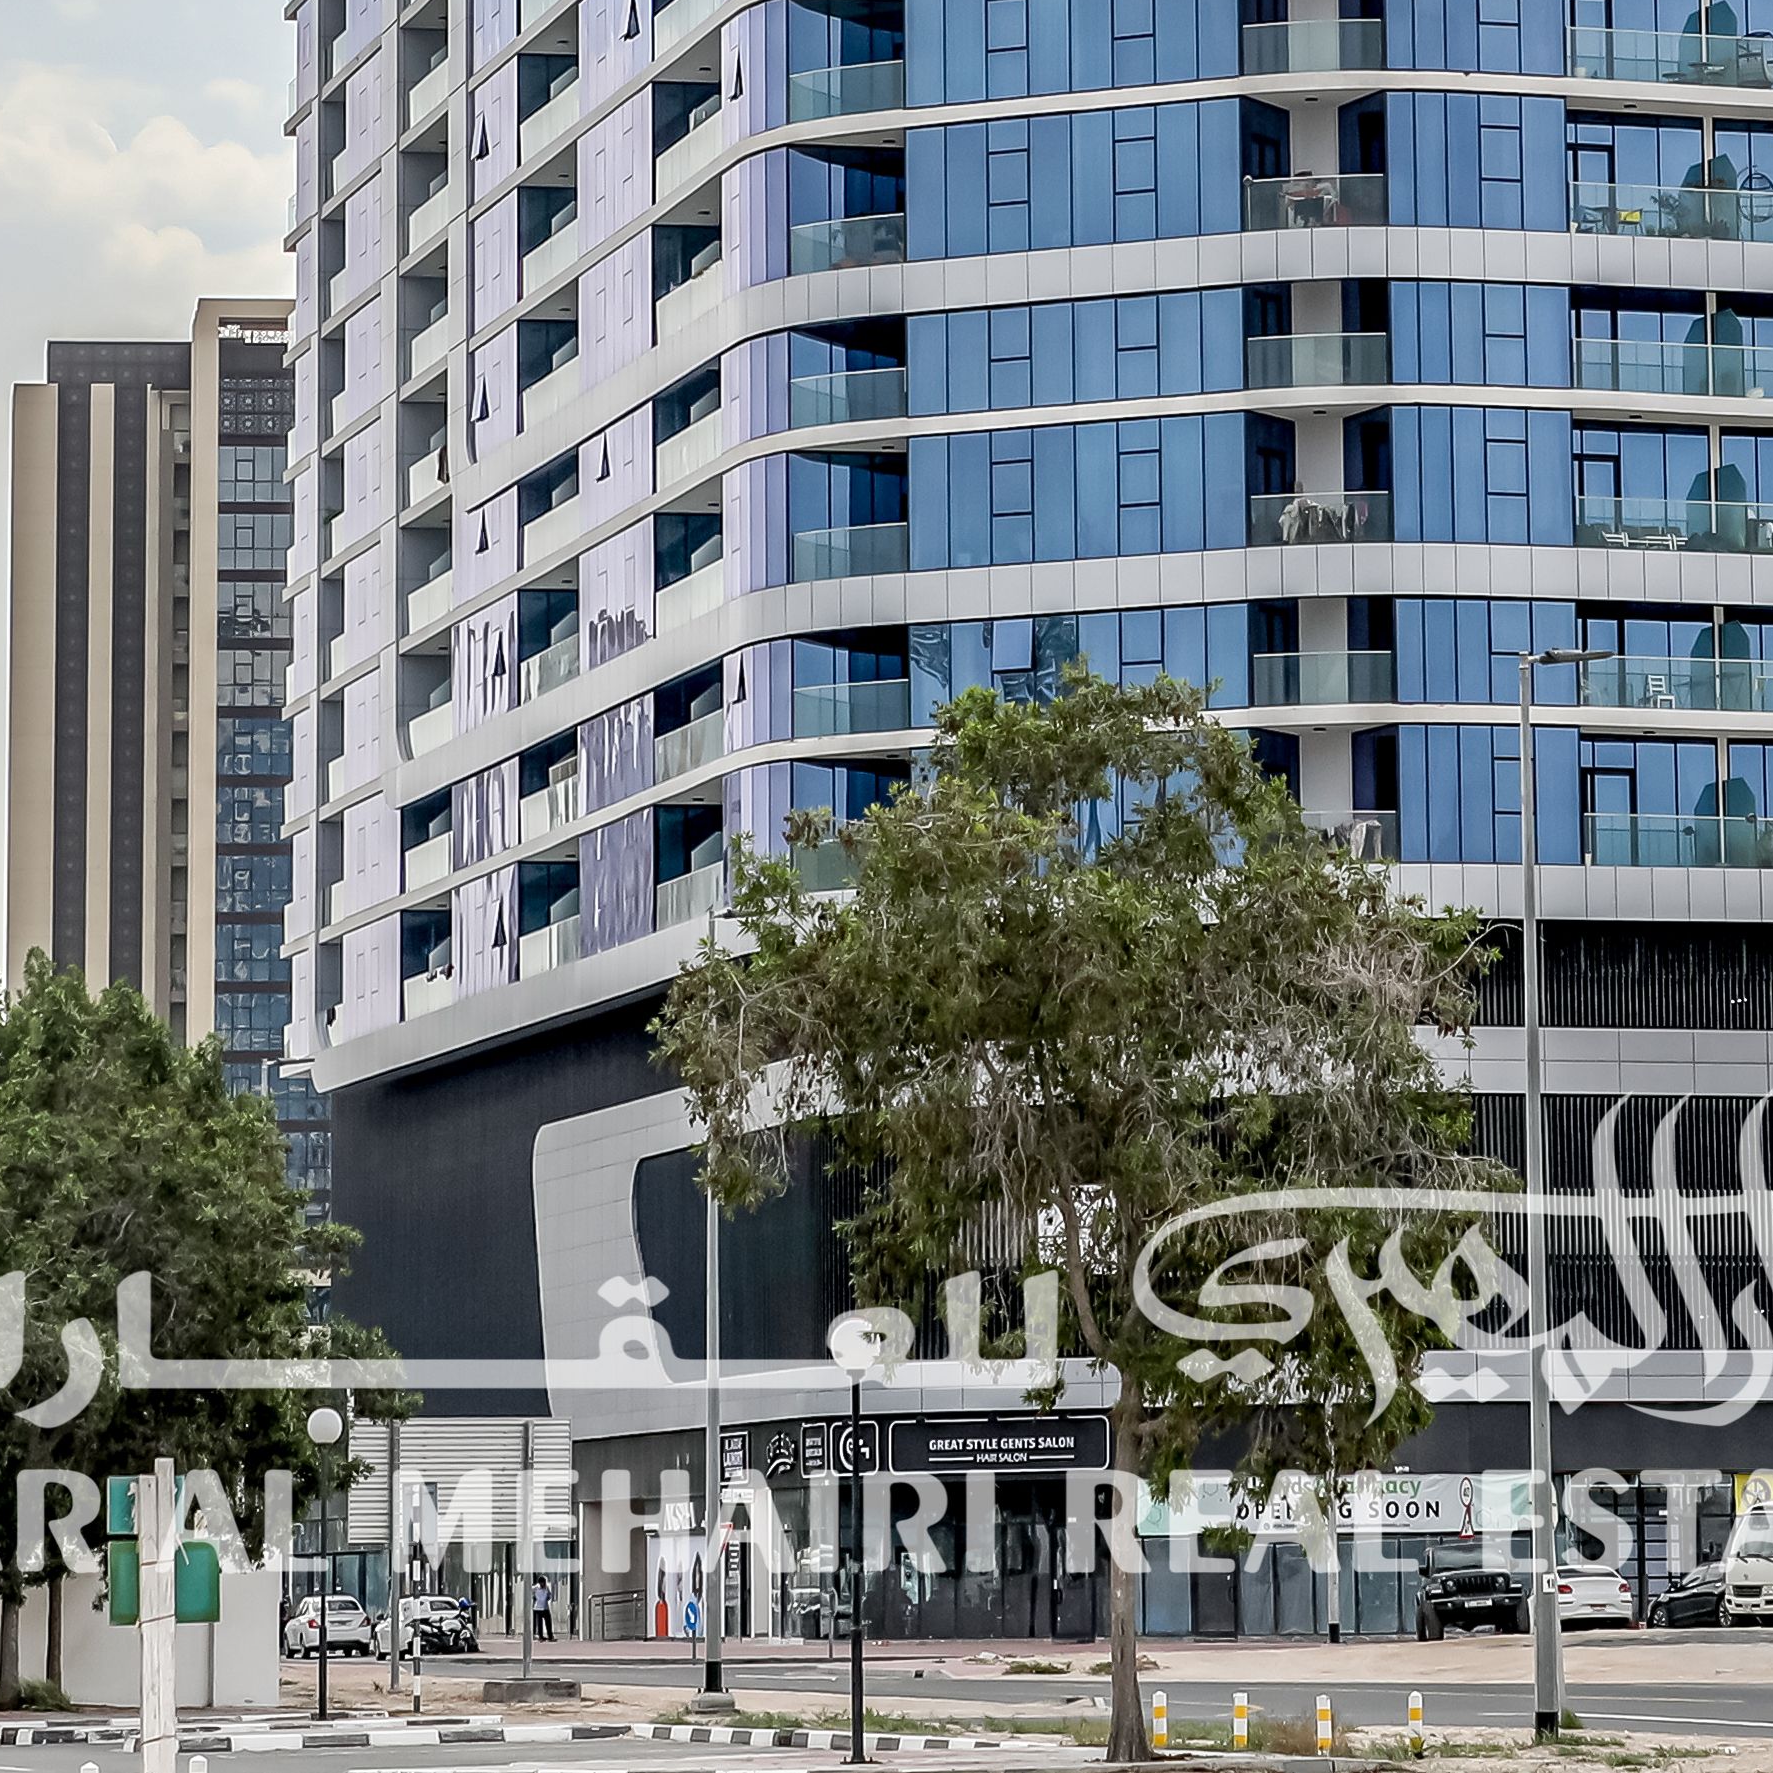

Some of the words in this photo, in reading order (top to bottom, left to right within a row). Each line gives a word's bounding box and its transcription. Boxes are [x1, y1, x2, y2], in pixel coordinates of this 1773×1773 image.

[929, 1438, 964, 1451] GREAT
[965, 1437, 998, 1450] STYLE
[1000, 1436, 1036, 1449] GENTS
[1037, 1436, 1075, 1448] SALON
[998, 1452, 1027, 1462] SALON
[1236, 1500, 1352, 1519] OPEG
[1368, 1500, 1440, 1519] SOON
